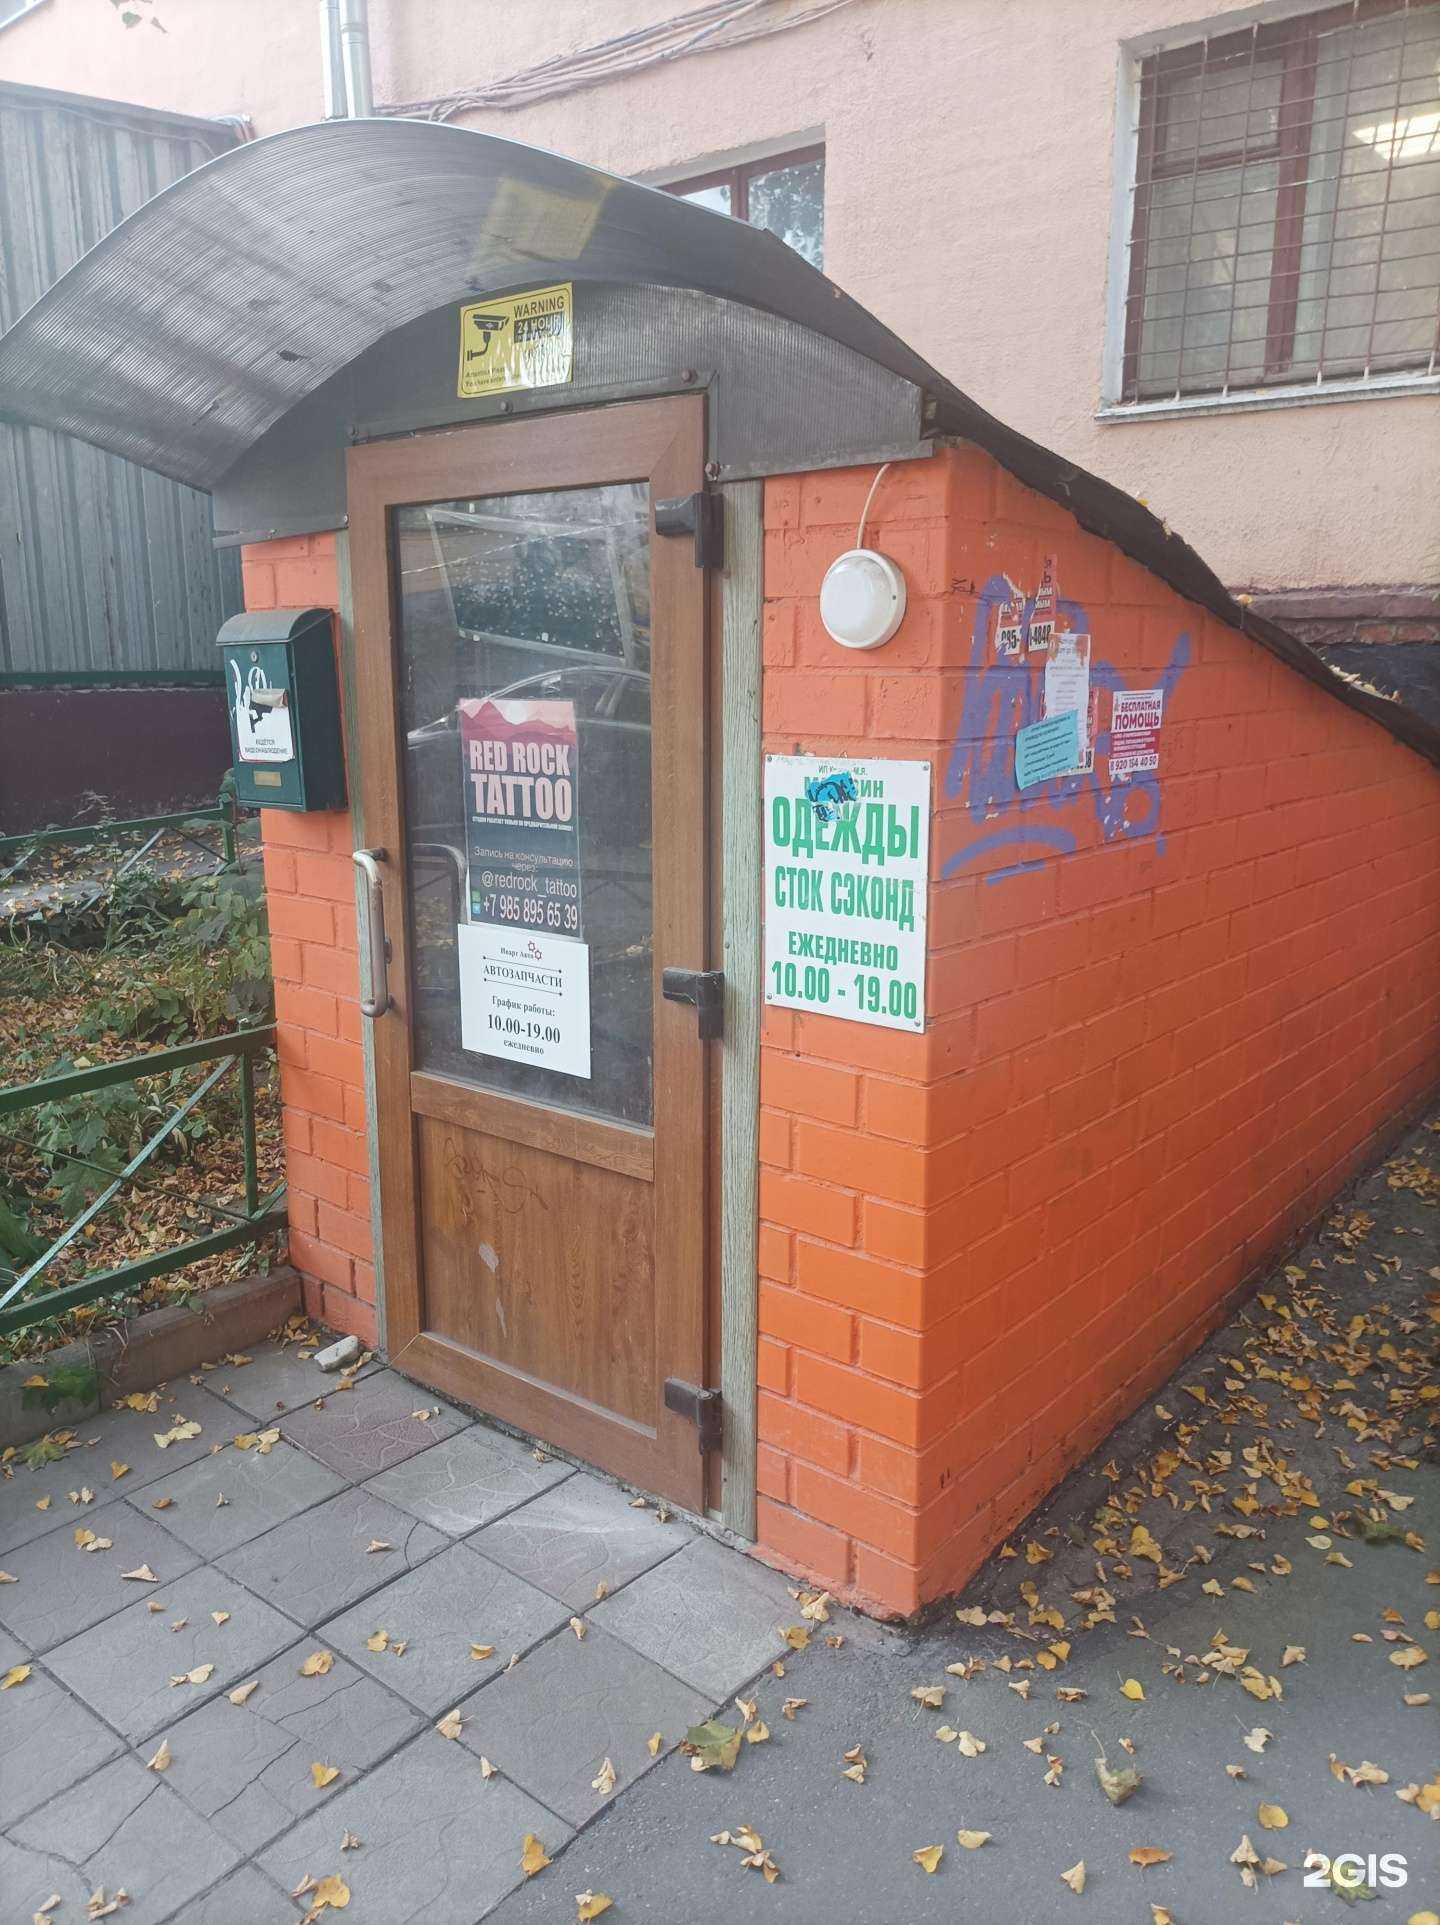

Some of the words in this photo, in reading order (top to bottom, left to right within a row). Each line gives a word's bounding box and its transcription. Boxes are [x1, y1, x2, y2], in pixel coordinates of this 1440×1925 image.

[514, 296, 564, 318] WARNING
[517, 321, 528, 333] 24
[1121, 701, 1161, 713] БЕСПЛАТНАЯ
[1115, 711, 1159, 730] ПОМОЩЬ
[469, 740, 507, 771] RED
[512, 742, 570, 776] ROCK
[1116, 759, 1127, 770] 920
[470, 773, 572, 822] TATTOO
[772, 796, 920, 866] ОДЕЖДЫ
[474, 846, 503, 858] Запись
[515, 853, 574, 867] консультацию
[511, 862, 538, 873] через:
[482, 870, 577, 898] @redrock_tattoo
[775, 865, 824, 912] СТОК
[831, 871, 915, 932] СЭКОНД
[483, 894, 497, 917] +7
[500, 895, 520, 920] 985
[523, 898, 544, 924] 895
[547, 900, 561, 927] 65
[564, 904, 578, 930] 39
[788, 931, 898, 971] ЕЖЕДНЕВНО
[483, 965, 562, 988] АВТОЗАПЧАСТИ
[772, 961, 830, 1003] 10.00
[854, 974, 917, 1019] 19.00
[492, 995, 522, 1010] График
[523, 1003, 556, 1017] работы:
[488, 1014, 561, 1044] 10.00-19.00
[503, 1040, 545, 1055] ежедневно
